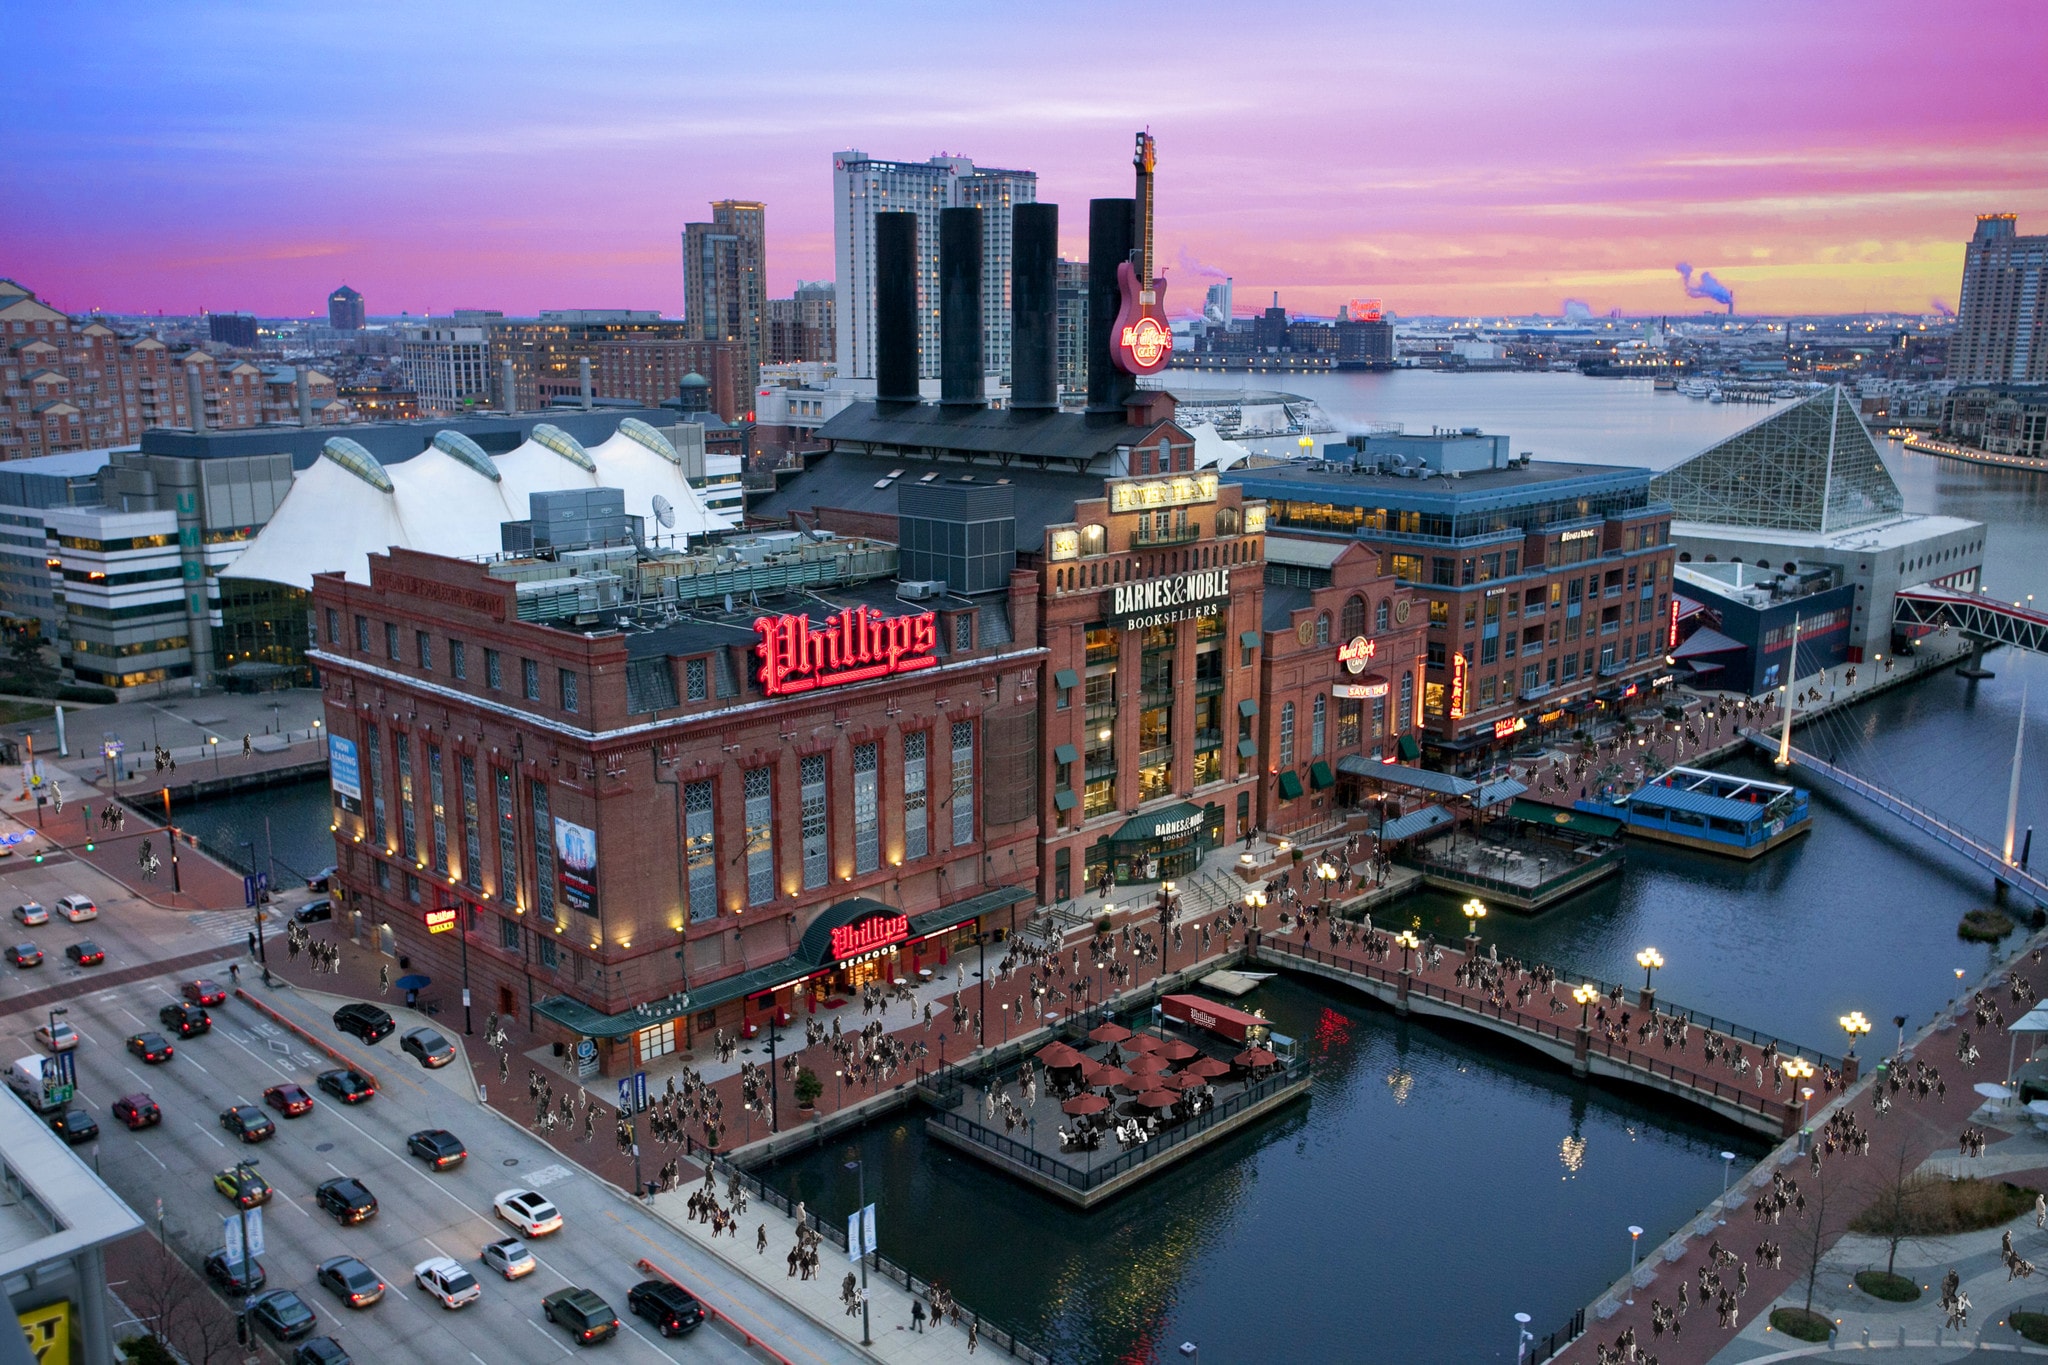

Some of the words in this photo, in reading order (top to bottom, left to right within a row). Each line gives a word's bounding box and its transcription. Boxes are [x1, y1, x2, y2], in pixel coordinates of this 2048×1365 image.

[1118, 486, 1167, 507] POWER
[1171, 480, 1215, 502] PLANT
[177, 493, 200, 614] UMBI
[1127, 603, 1217, 631] BOOKSELLERS
[753, 604, 937, 697] Phillips
[1338, 643, 1358, 662] Hard
[1357, 639, 1376, 658] Rock
[1348, 687, 1370, 697] SAVE
[829, 913, 909, 960] Phillips
[840, 944, 897, 970] SEAFOOD
[277, 1051, 321, 1072] BUS
